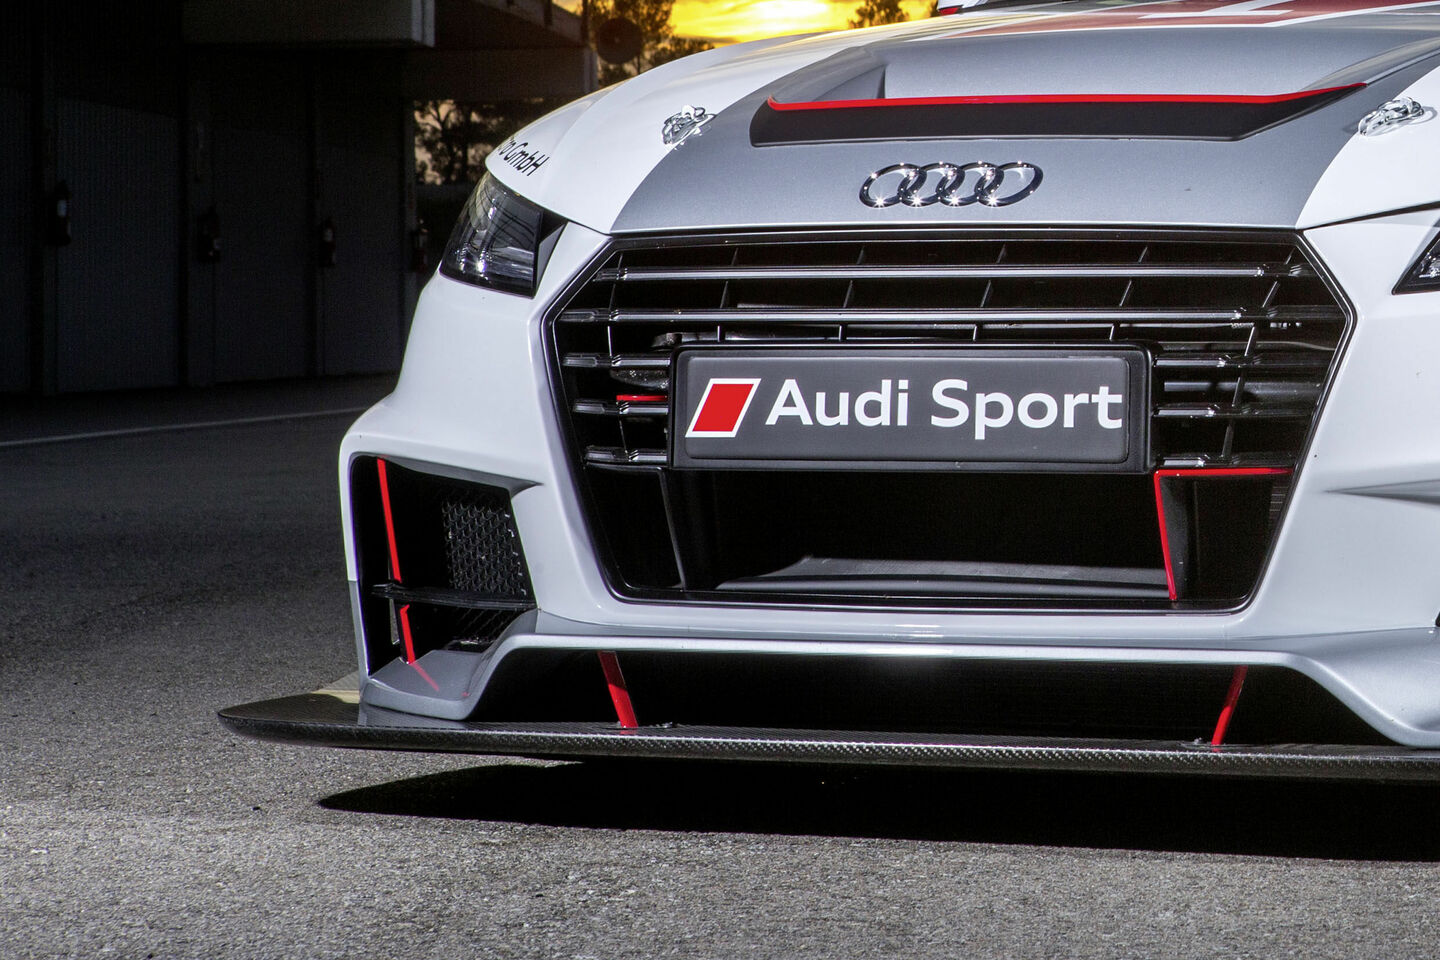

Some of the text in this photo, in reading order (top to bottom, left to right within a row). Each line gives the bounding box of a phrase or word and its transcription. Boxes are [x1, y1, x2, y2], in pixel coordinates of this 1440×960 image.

[503, 141, 550, 177] GmbH
[764, 378, 1123, 440] Audi Sport
